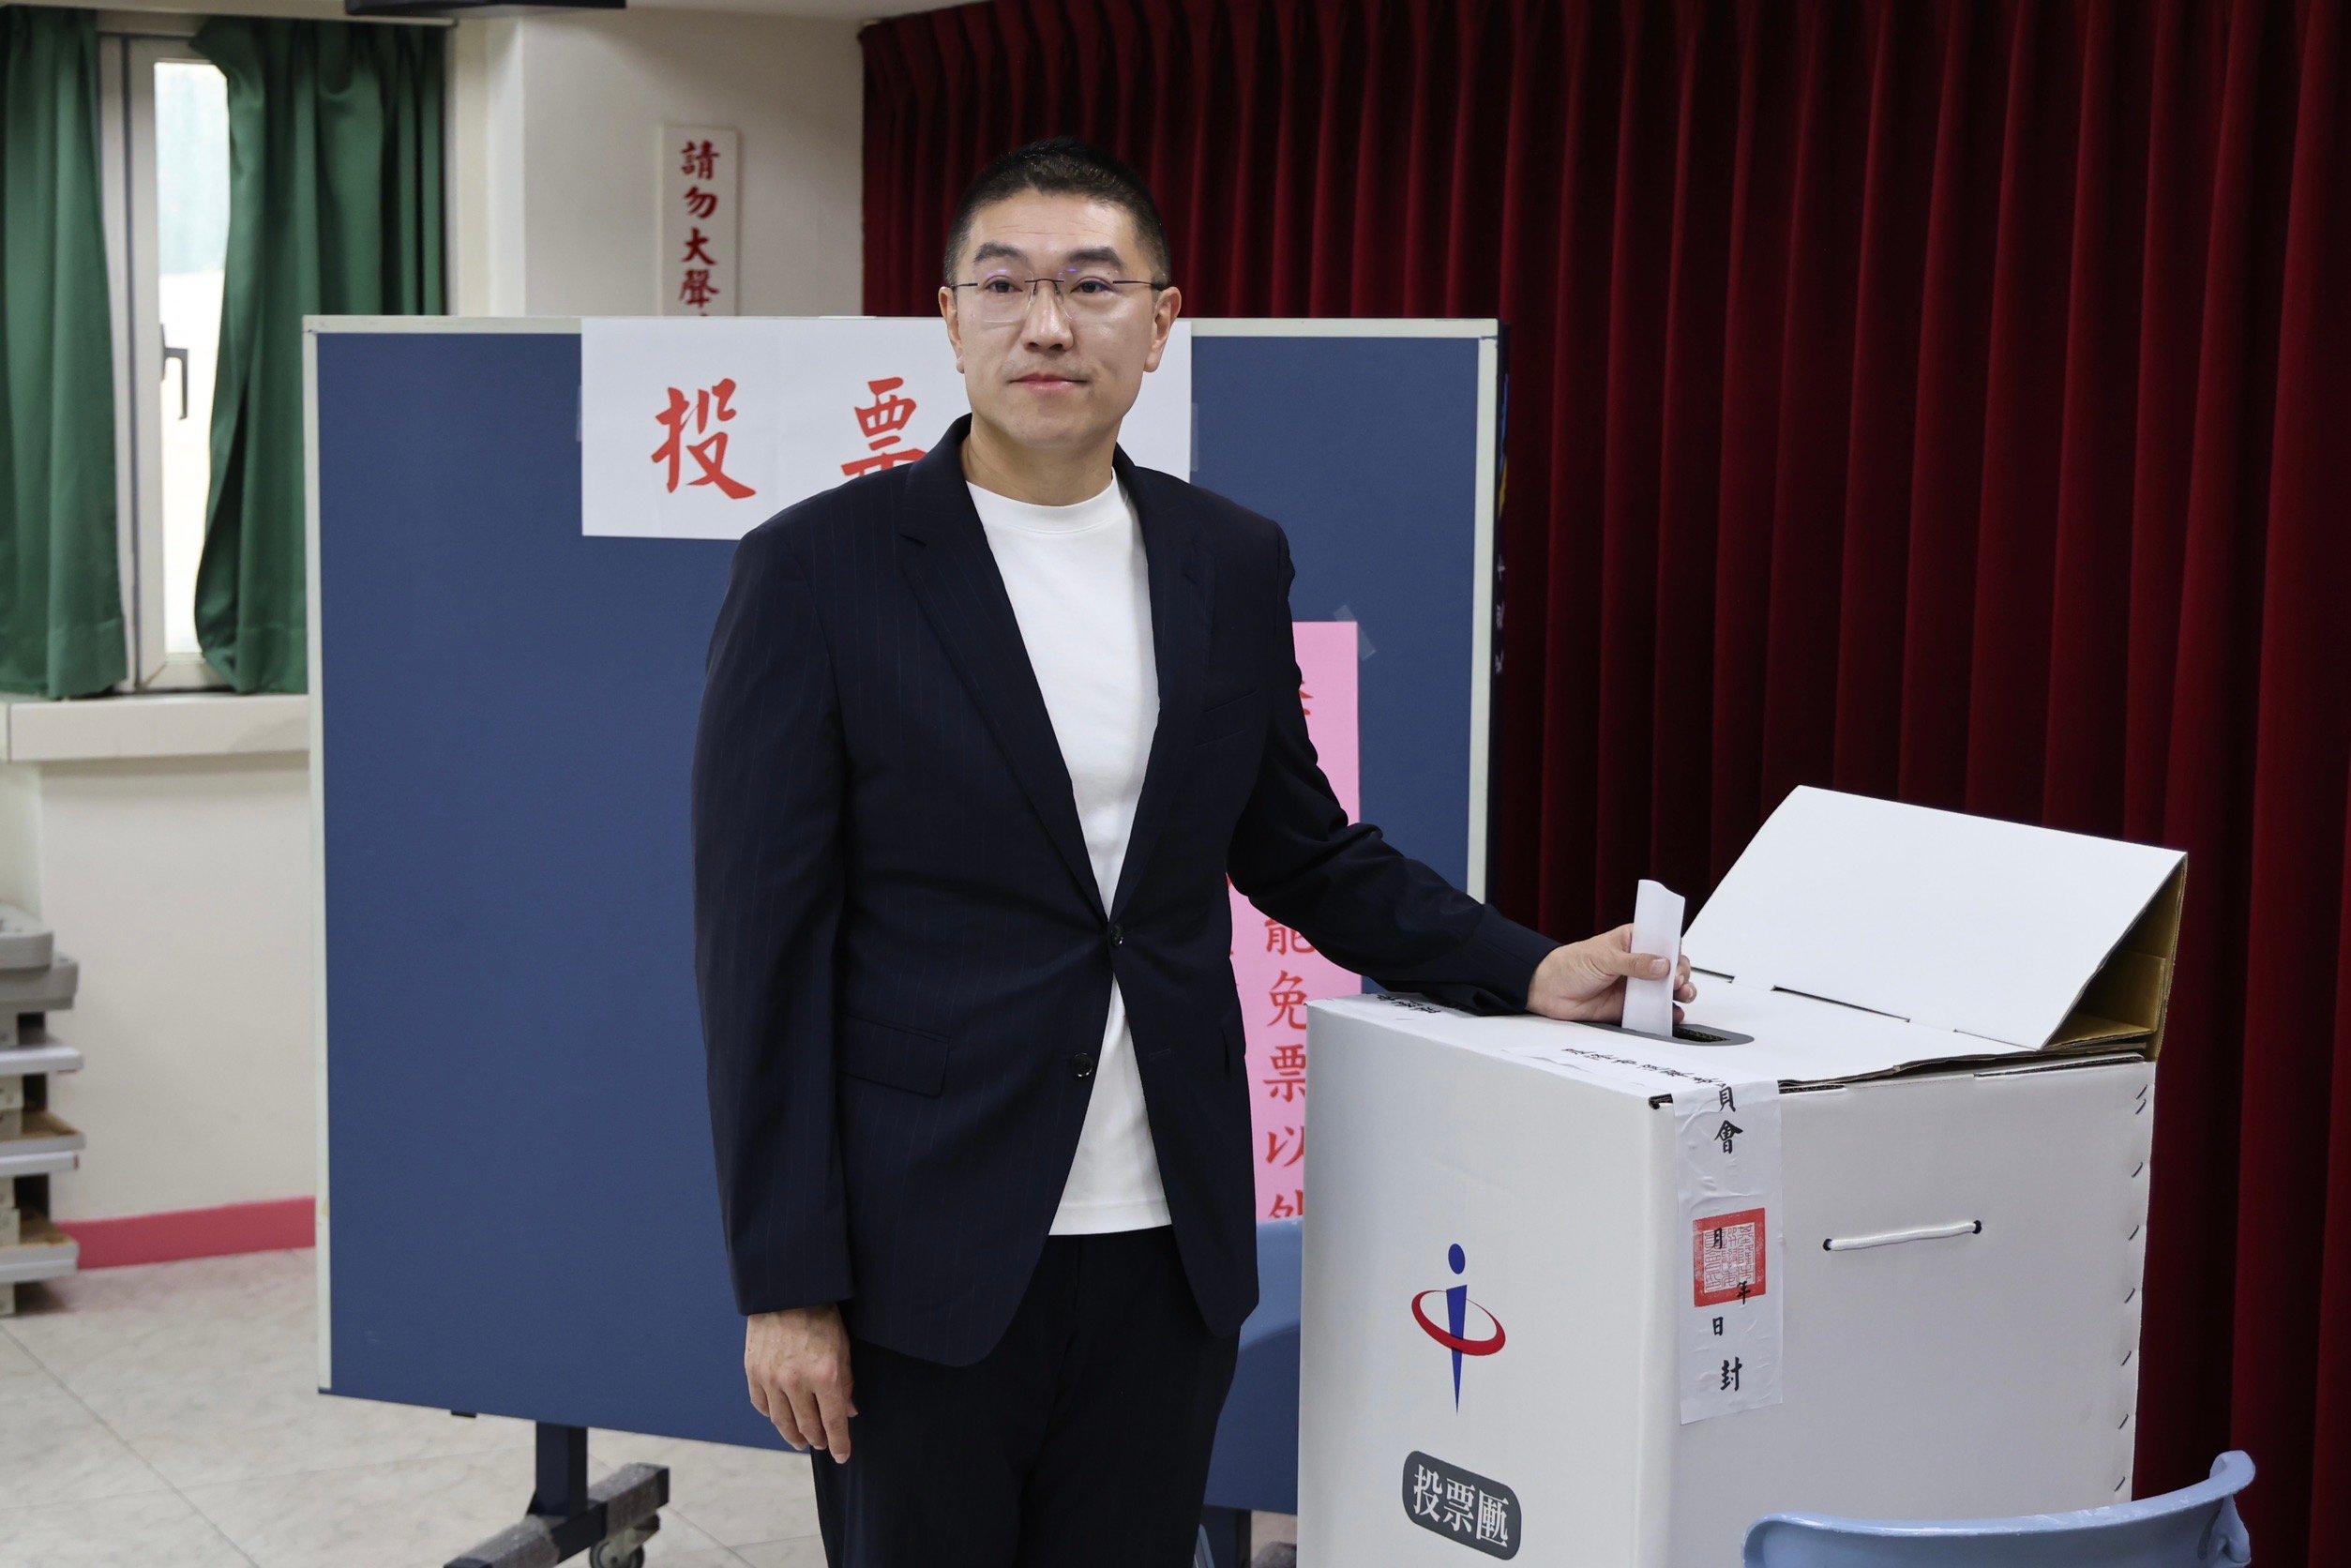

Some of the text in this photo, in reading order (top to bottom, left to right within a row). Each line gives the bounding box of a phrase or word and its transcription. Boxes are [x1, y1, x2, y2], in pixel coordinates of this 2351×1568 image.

[679, 140, 721, 317] 請勿大聲
[1413, 1463, 1510, 1548] 投票匭
